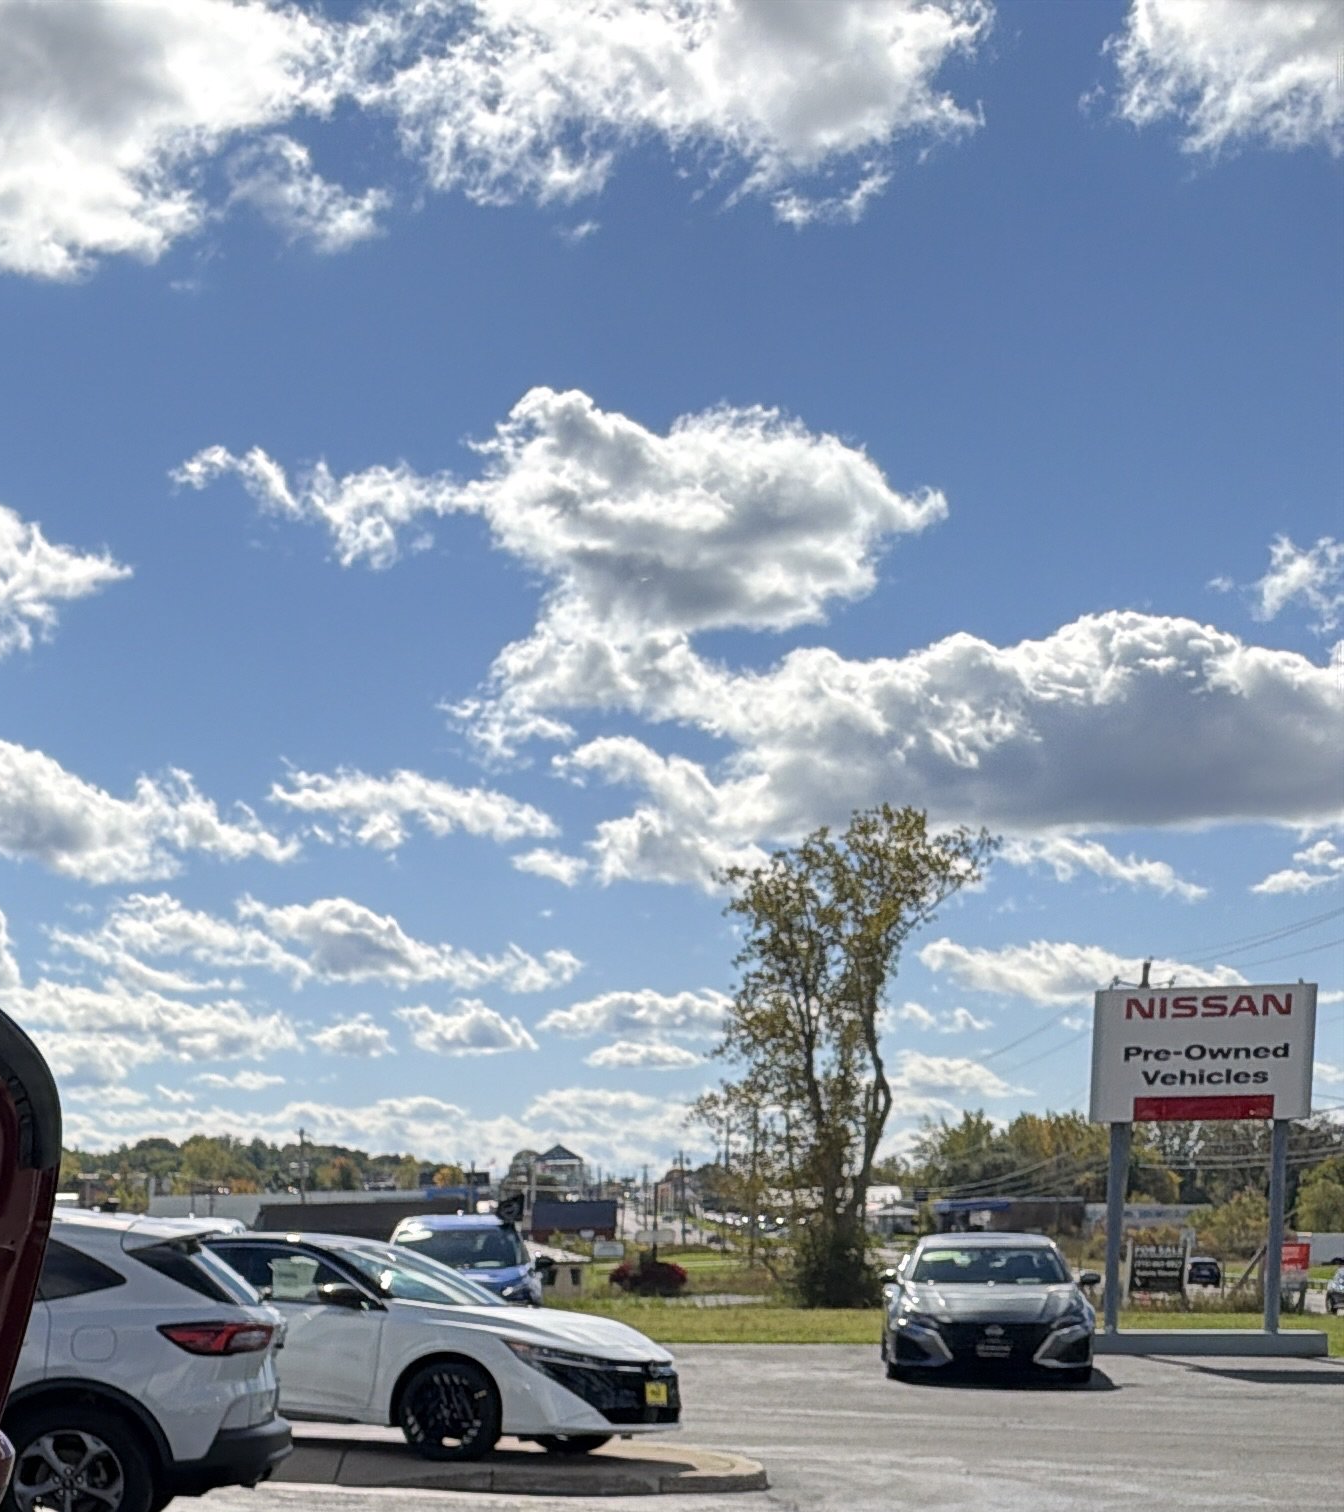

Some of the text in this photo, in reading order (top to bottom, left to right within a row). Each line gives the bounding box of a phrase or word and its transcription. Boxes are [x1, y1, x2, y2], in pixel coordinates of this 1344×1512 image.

[1125, 993, 1293, 1020] NISSAN
[1123, 1042, 1291, 1063] Pre-Owned
[1141, 1068, 1270, 1086] Vehicles
